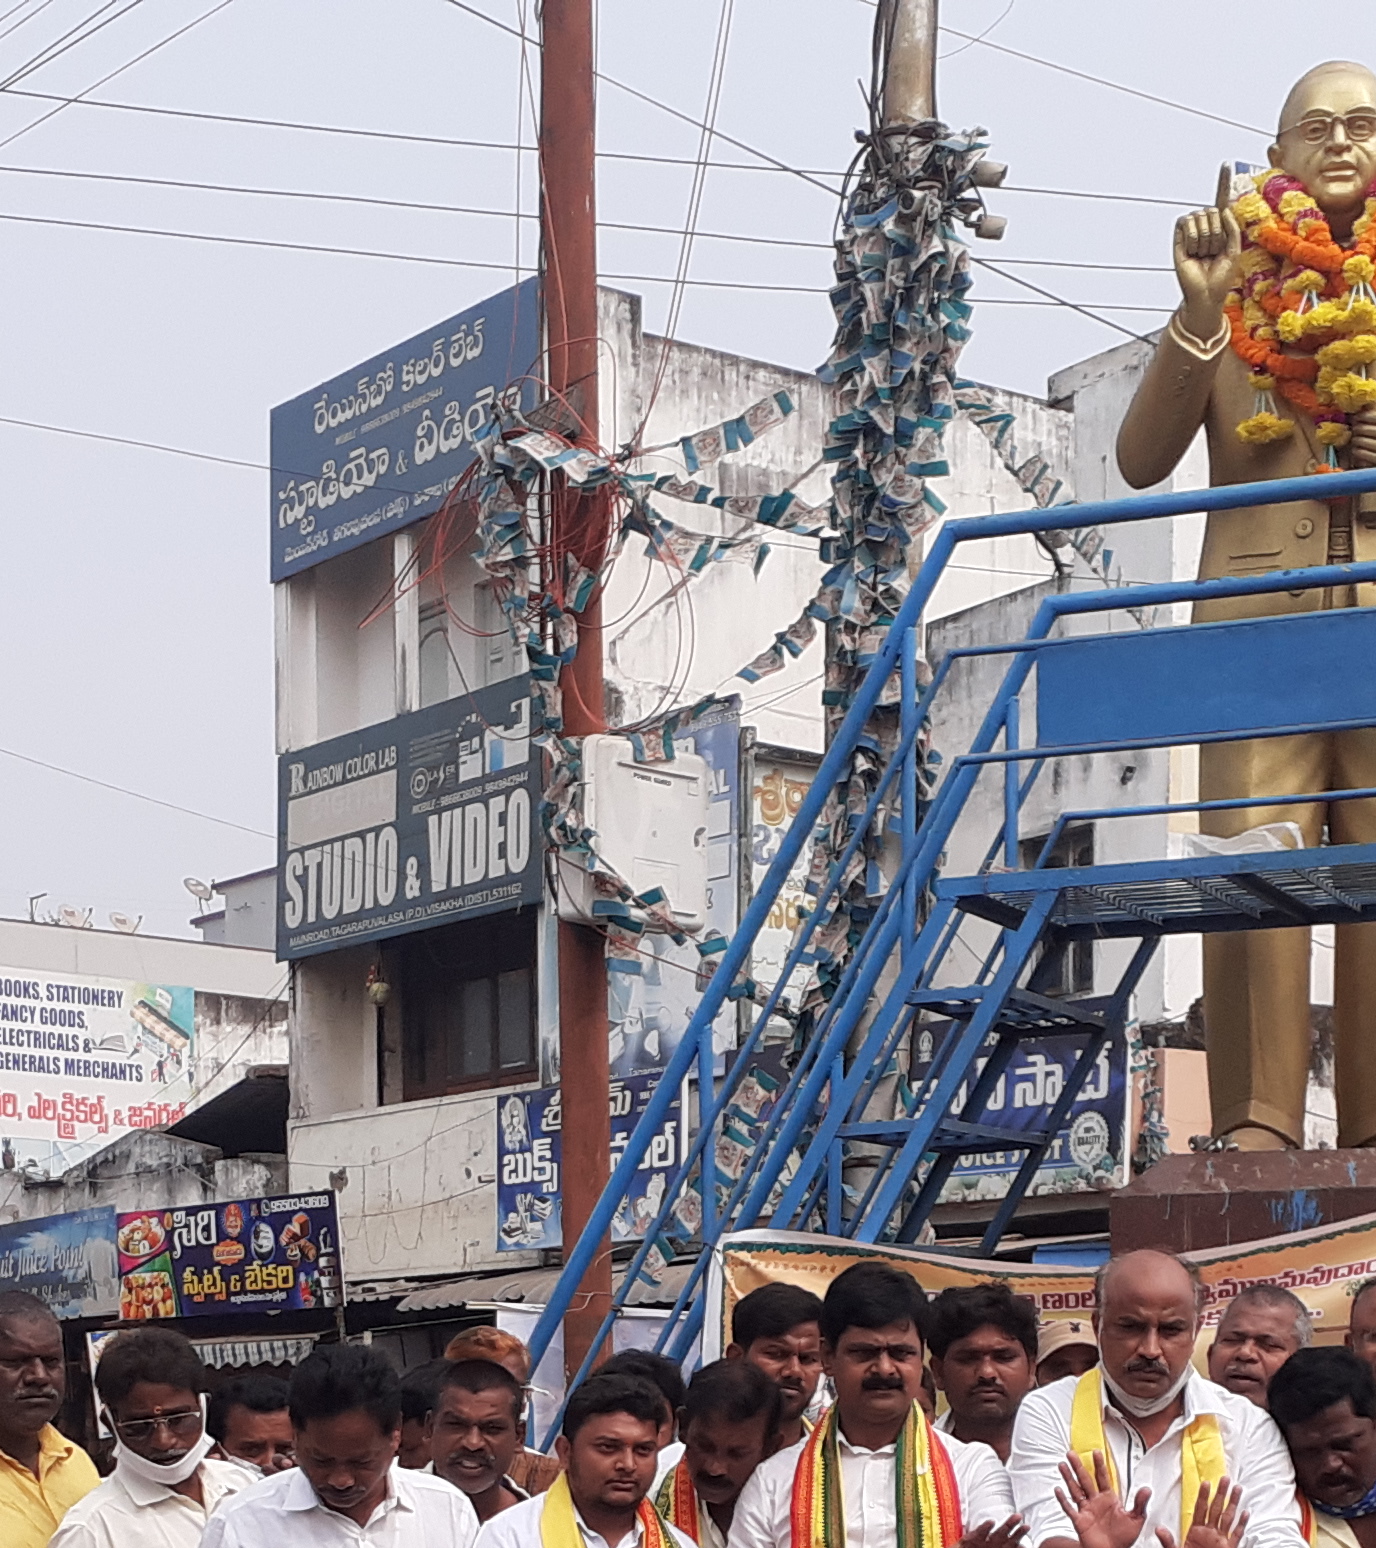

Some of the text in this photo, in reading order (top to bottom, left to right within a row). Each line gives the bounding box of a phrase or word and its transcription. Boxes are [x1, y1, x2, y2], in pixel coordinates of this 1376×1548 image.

[396, 450, 409, 475] &
[288, 762, 343, 797] RAINBOW
[345, 752, 377, 780] COLOR
[378, 746, 397, 769] LAB
[285, 826, 398, 928] STUDIO
[405, 856, 421, 899] &
[428, 788, 531, 892] VIDEO
[46, 983, 124, 1009] STATIONERY
[40, 1007, 89, 1031] GOODS,
[83, 1037, 93, 1054] &
[64, 1057, 144, 1083] MERCHANTS
[114, 1109, 126, 1126] &
[15, 1247, 48, 1283] Juice
